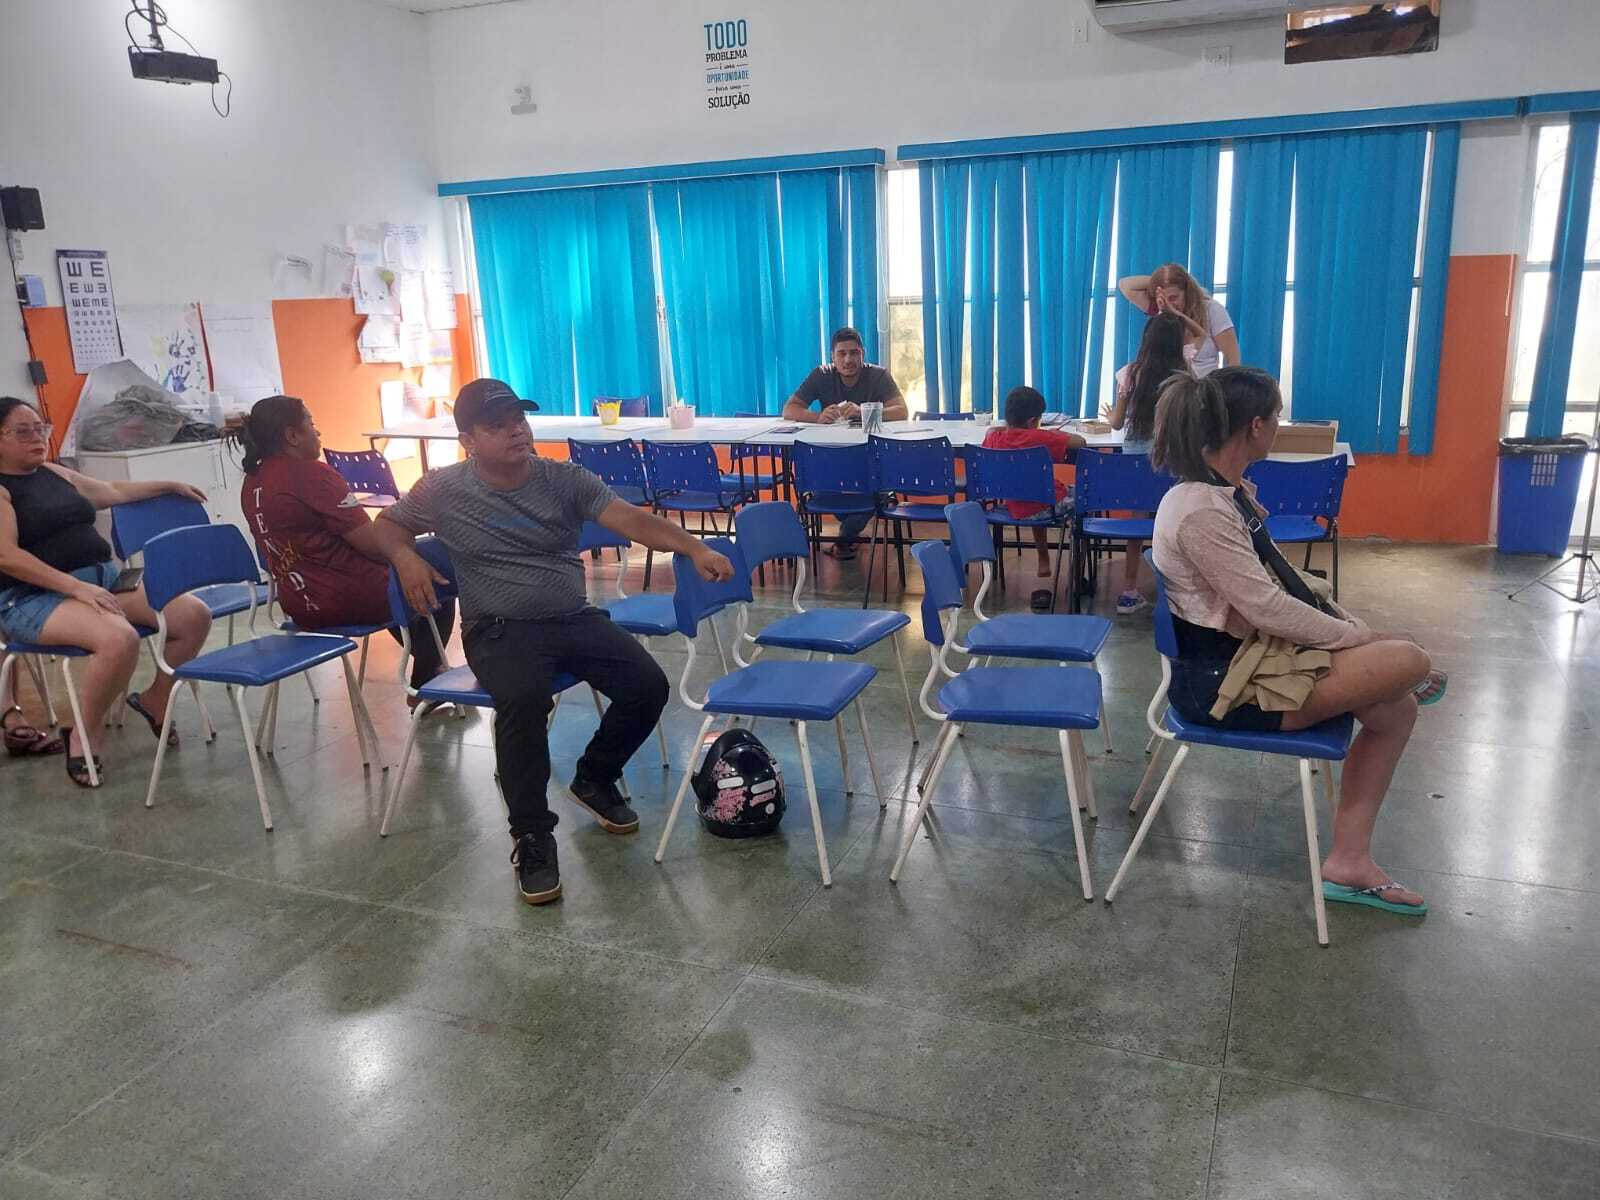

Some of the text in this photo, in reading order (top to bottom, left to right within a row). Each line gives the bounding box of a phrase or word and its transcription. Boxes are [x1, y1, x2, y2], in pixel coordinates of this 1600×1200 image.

[704, 19, 748, 51] TODO
[705, 49, 748, 63] PROBLEMA
[706, 70, 750, 83] OPORTUNIDADE
[707, 92, 751, 110] SOLUÇÃO
